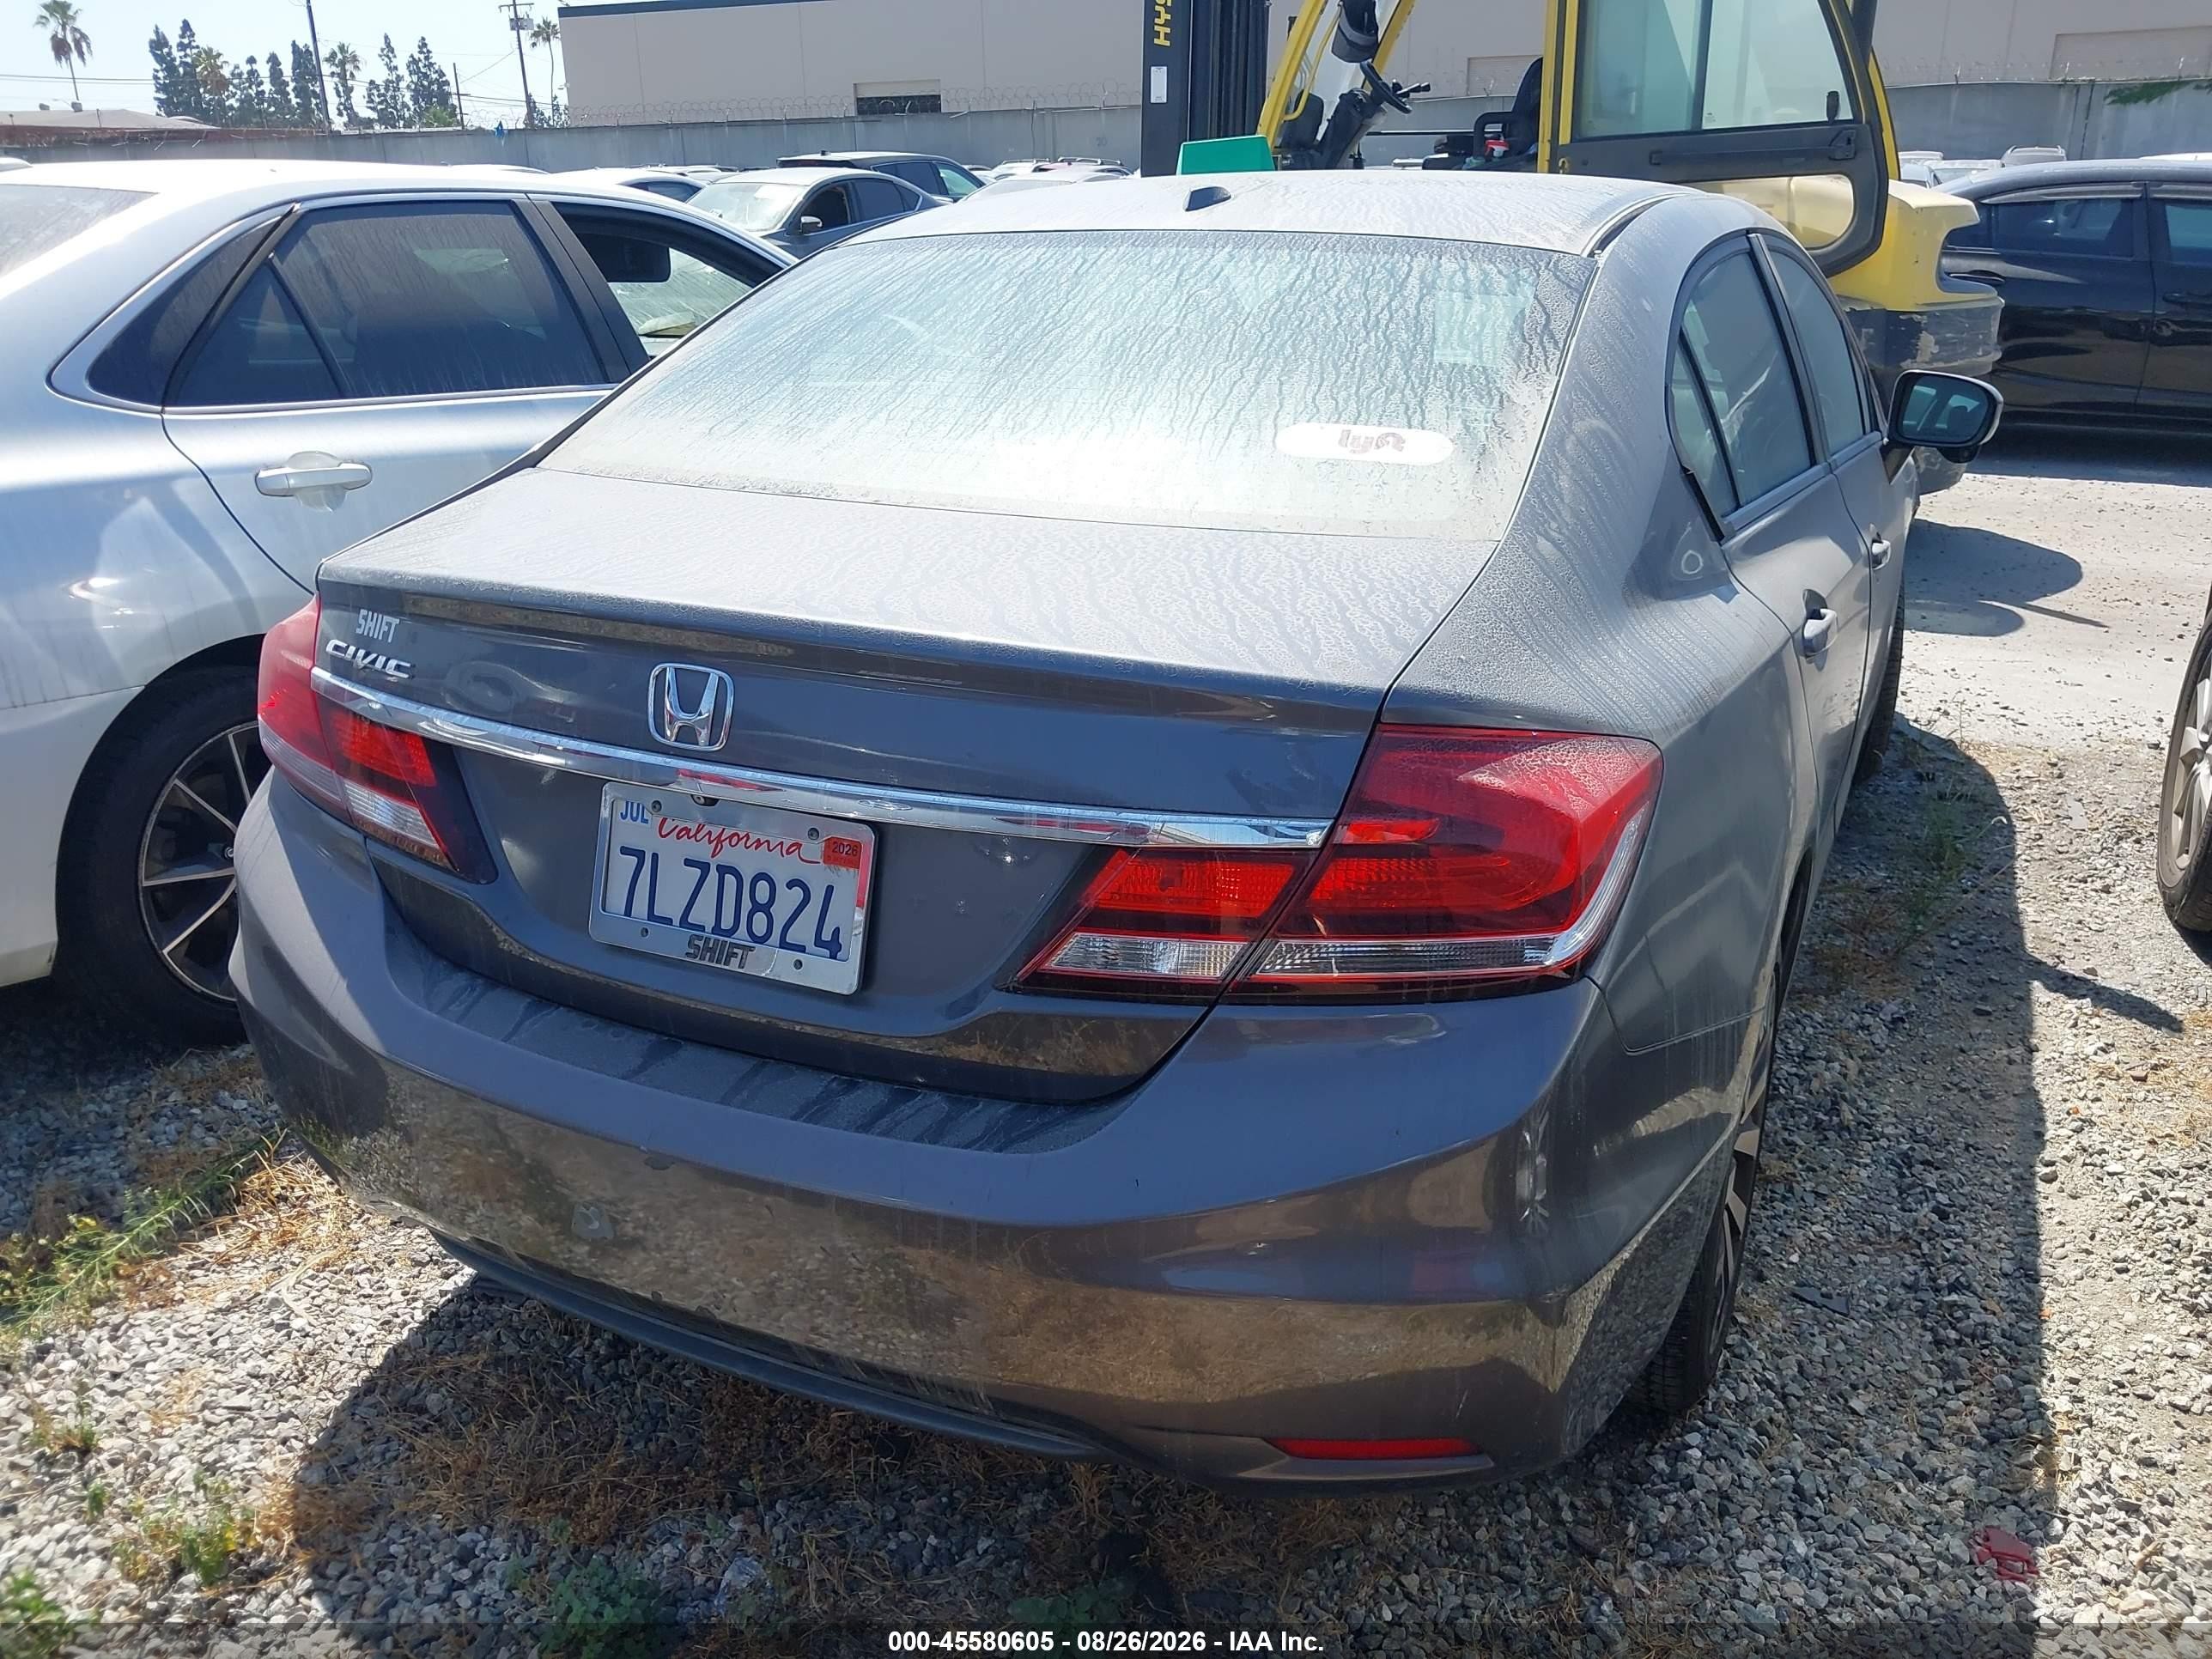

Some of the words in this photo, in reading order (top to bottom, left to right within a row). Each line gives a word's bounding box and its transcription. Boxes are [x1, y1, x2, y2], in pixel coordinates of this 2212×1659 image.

[356, 608, 400, 643] SHIFT
[325, 639, 411, 679] CIVIC
[620, 800, 649, 824] JUL
[658, 817, 822, 865] California
[831, 841, 859, 857] 2026
[619, 845, 843, 962] 7LZD824
[685, 934, 756, 970] SHIFT
